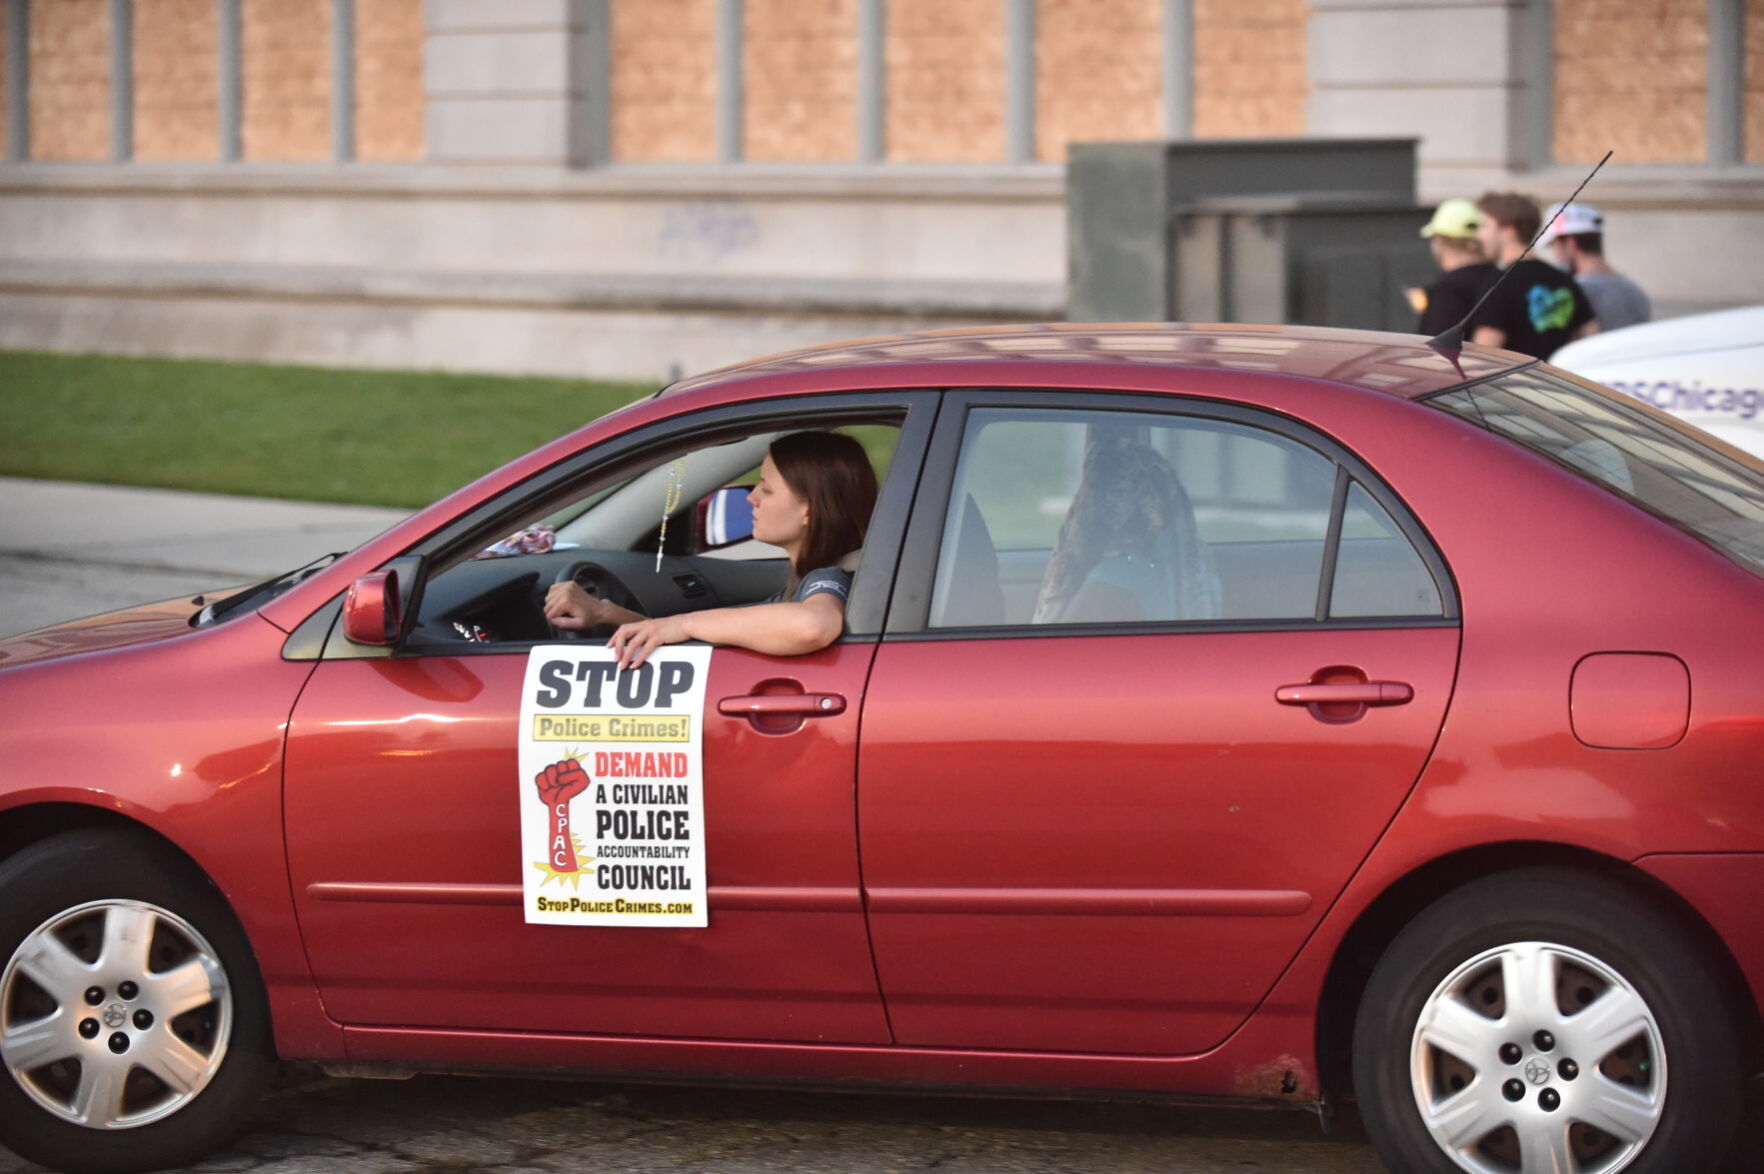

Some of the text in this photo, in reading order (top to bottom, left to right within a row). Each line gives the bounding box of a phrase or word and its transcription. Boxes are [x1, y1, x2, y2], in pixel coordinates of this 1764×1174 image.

[536, 660, 695, 708] STOP
[540, 718, 687, 737] Police Crimes!
[595, 752, 688, 777] DEMAND
[596, 784, 688, 804] A CIVILIAN
[553, 803, 569, 867] CPAC
[596, 810, 690, 840] POLICE
[597, 845, 690, 859] ACCOUNTABILITY
[597, 864, 691, 890] COUNCIL
